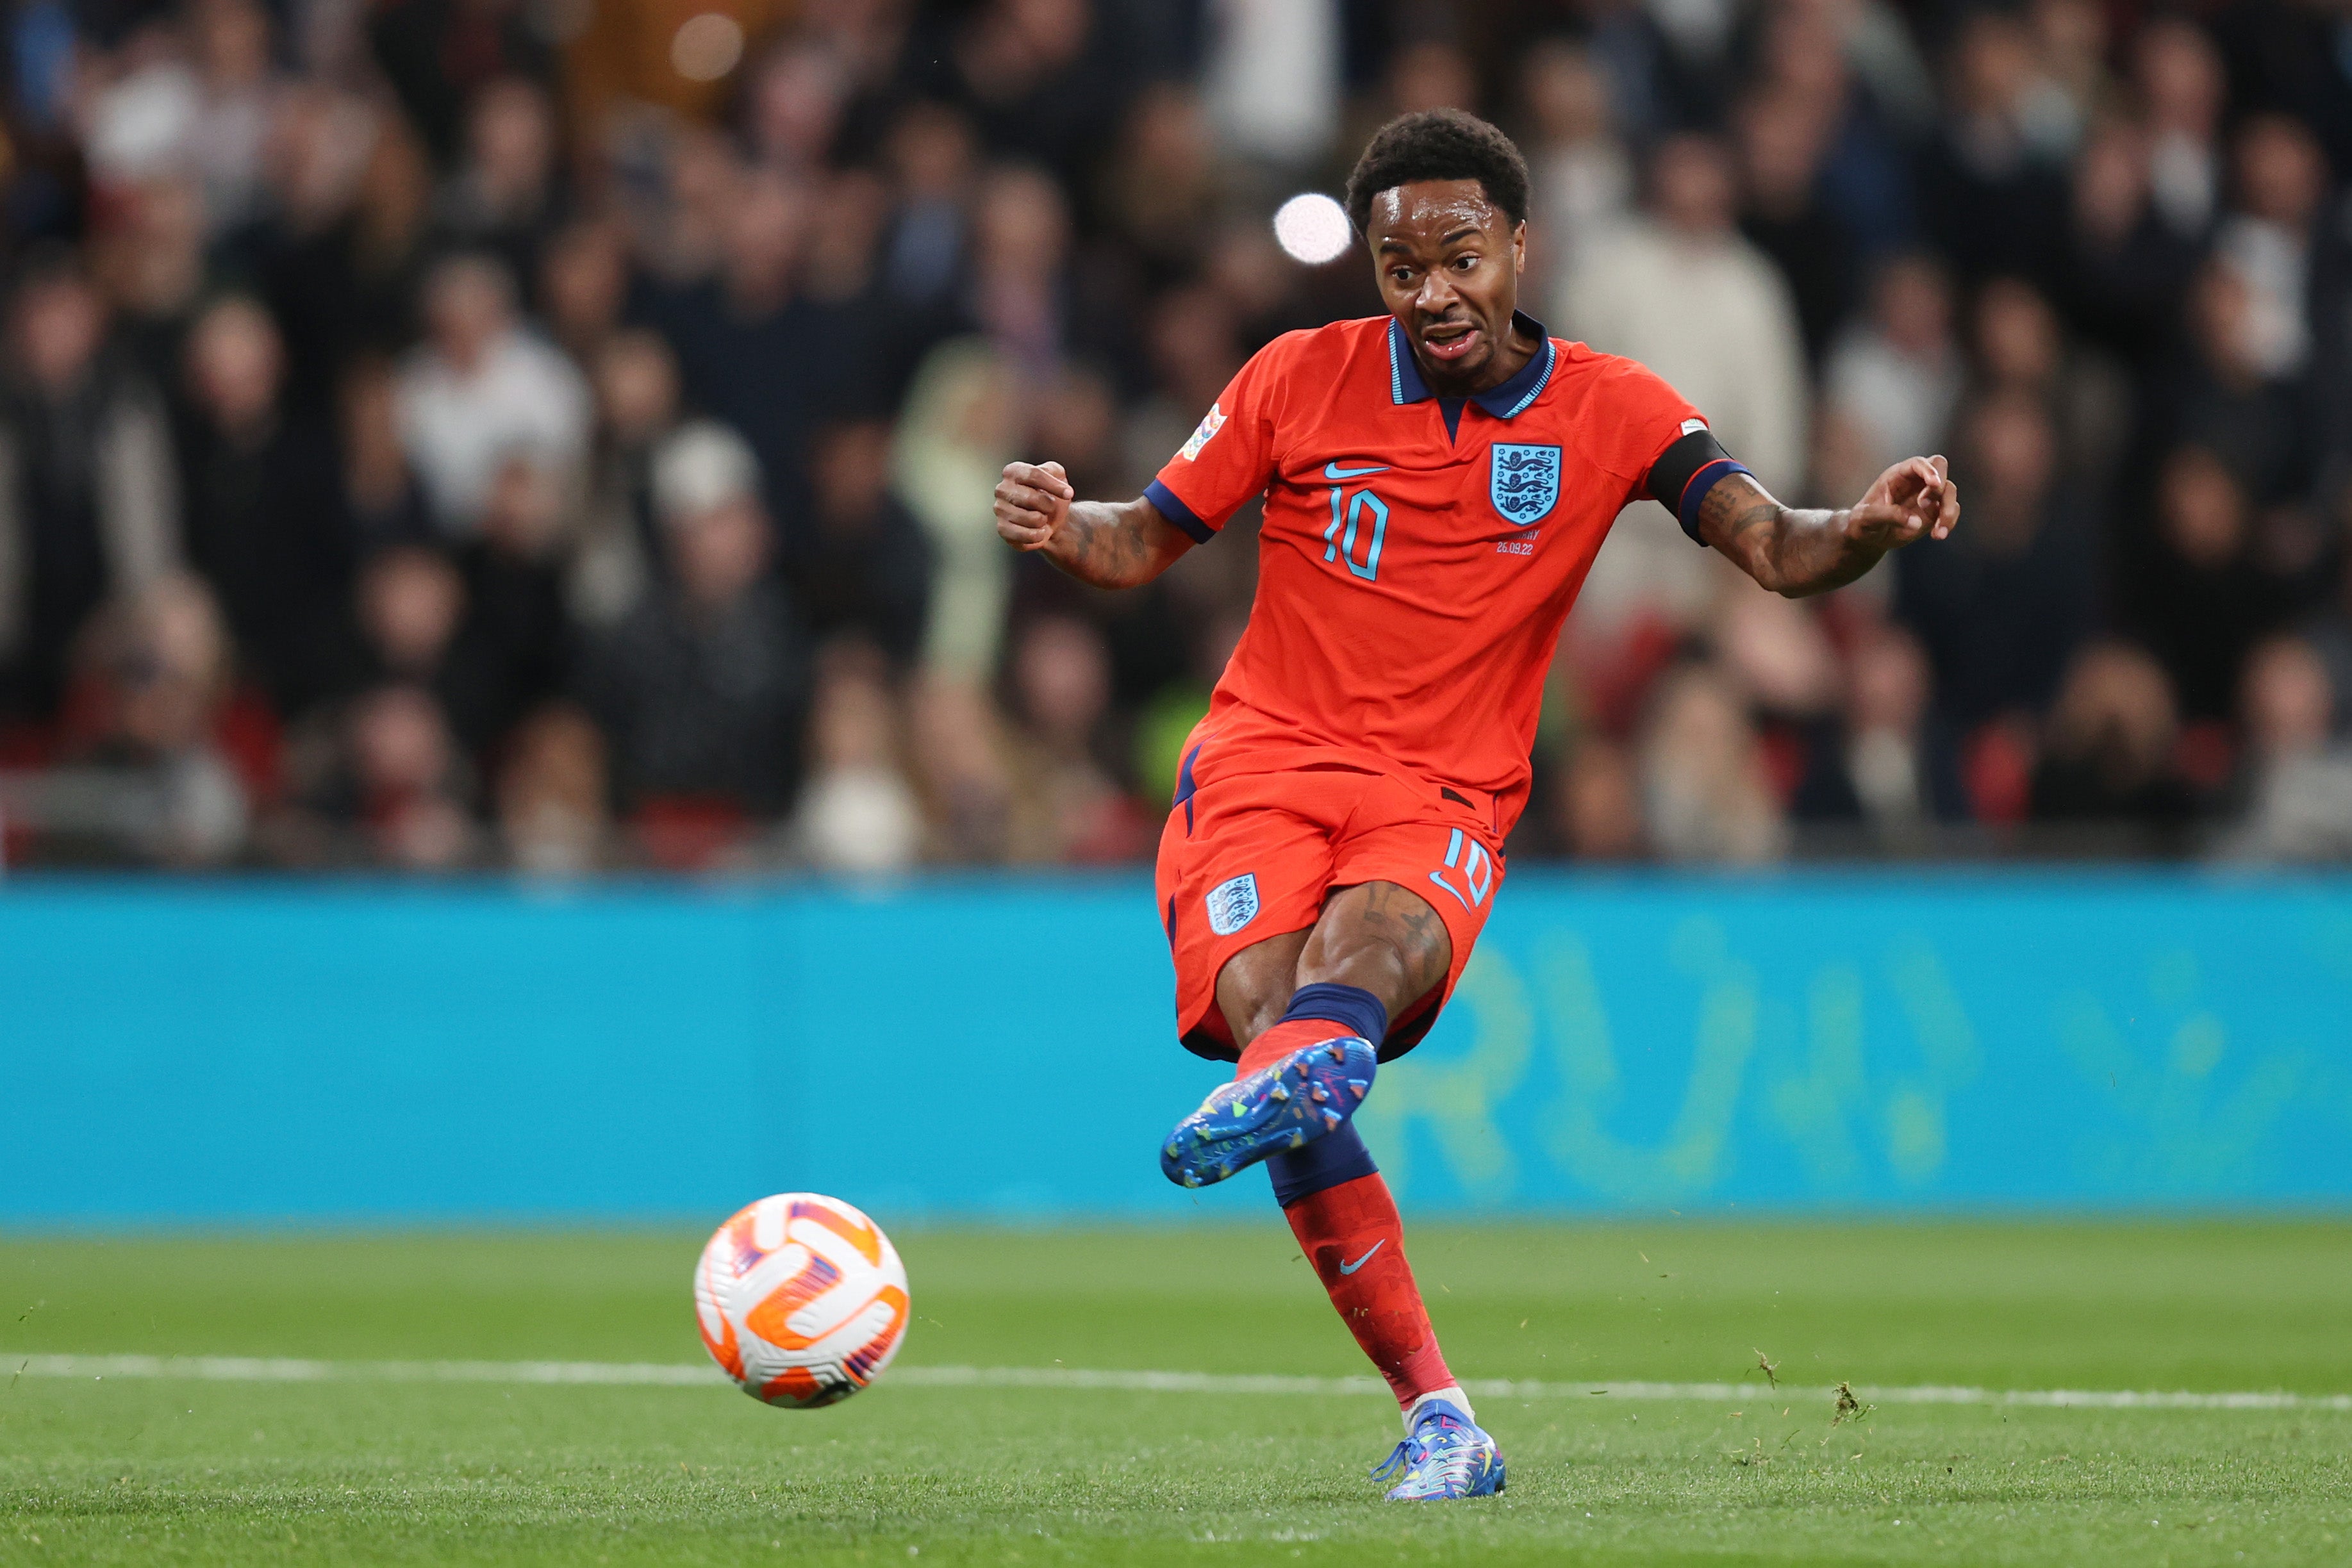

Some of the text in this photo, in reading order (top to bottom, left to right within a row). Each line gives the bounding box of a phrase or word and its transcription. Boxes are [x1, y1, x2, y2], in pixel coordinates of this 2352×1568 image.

[1323, 484, 1389, 581] 10
[1496, 541, 1533, 556] 26.09.22
[1444, 827, 1493, 907] 10
